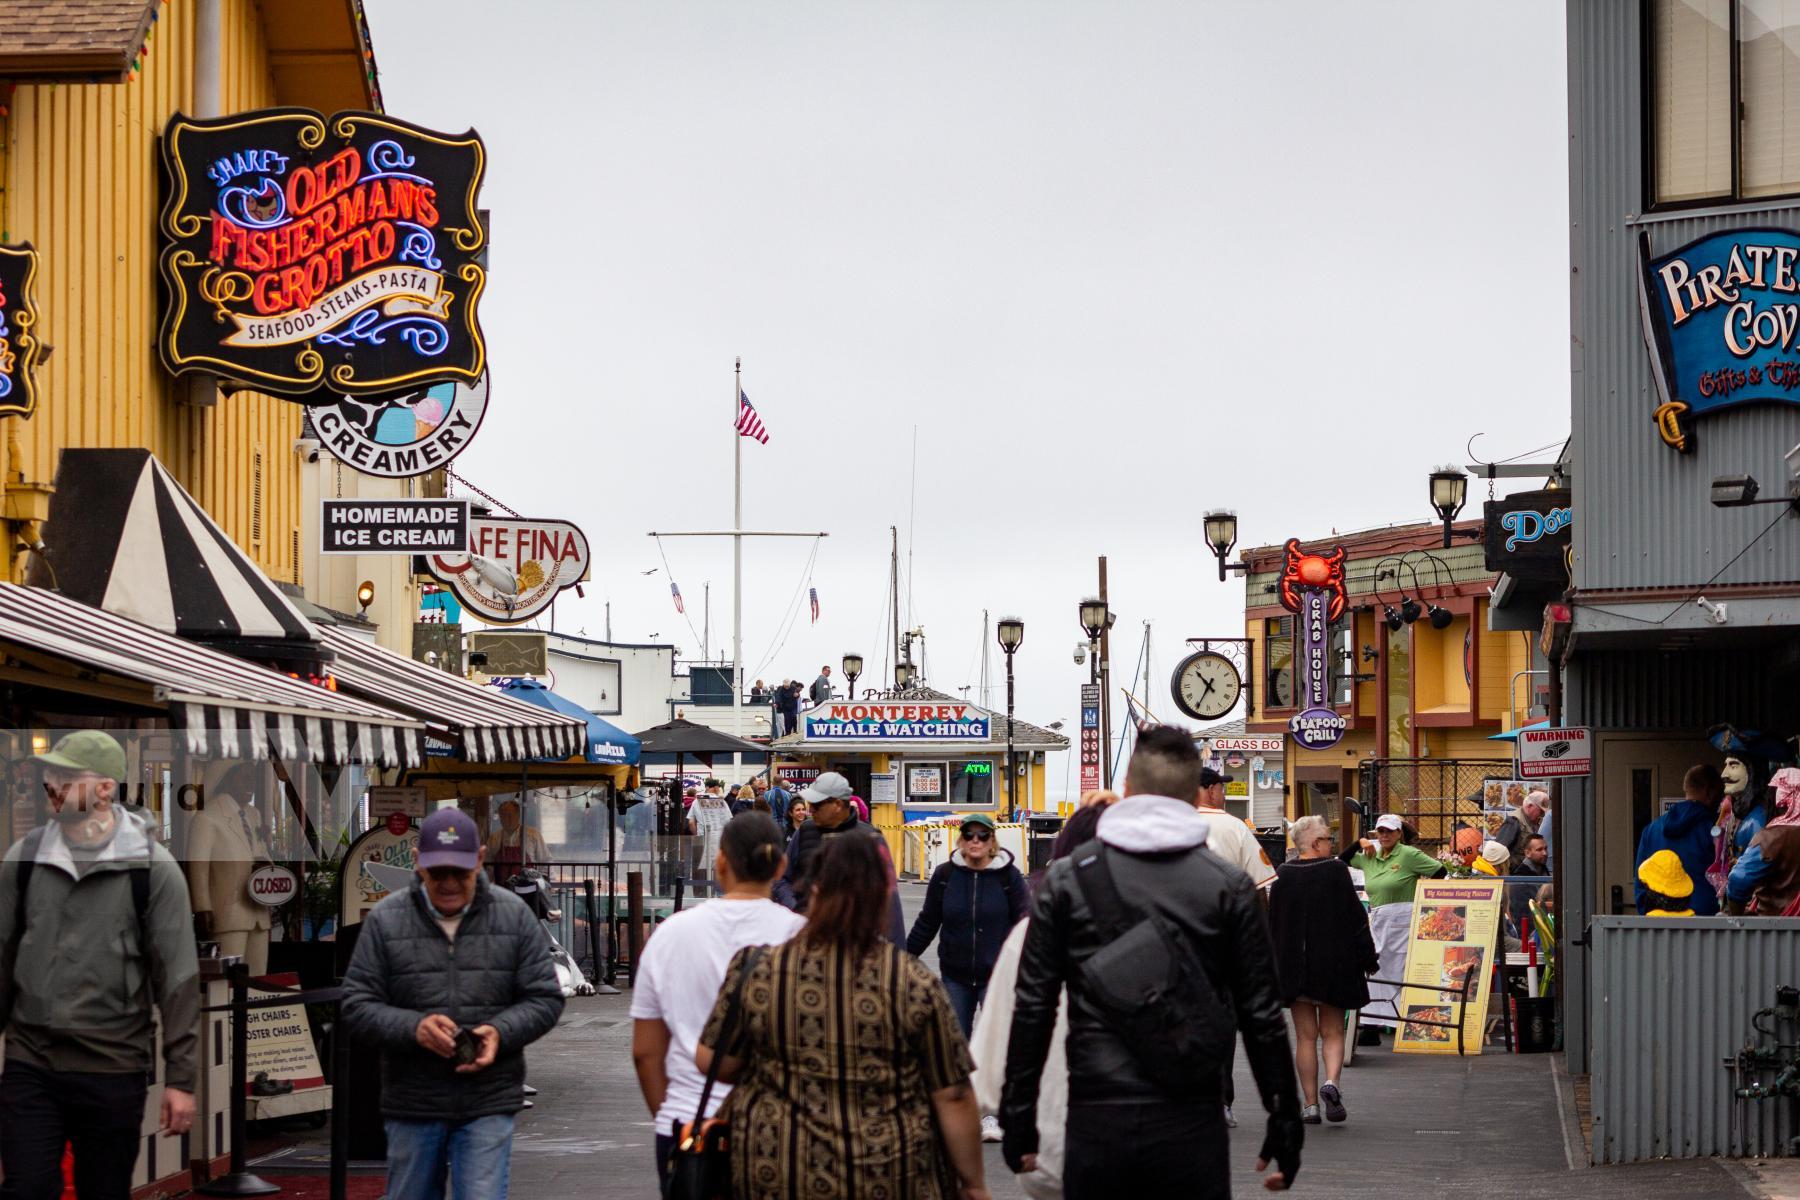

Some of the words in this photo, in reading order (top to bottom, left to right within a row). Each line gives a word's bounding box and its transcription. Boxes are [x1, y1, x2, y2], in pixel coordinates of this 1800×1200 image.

[286, 147, 361, 216] OLD
[209, 178, 439, 267] FISHERMAN'S
[253, 219, 396, 315] GROTTO
[1658, 244, 1800, 326] PIRATE
[1723, 300, 1800, 356] COV
[1699, 366, 1747, 397] Gifts
[1749, 366, 1762, 385] &
[319, 408, 473, 473] CREAMERY
[331, 507, 459, 524] HOMEMADE
[335, 529, 370, 546] ICE
[377, 529, 455, 546] CREAM
[516, 528, 580, 575] FINA
[1311, 598, 1322, 642] CRAB
[1312, 648, 1322, 703] HOUSE
[862, 688, 934, 701] Princess
[829, 705, 968, 721] MONTEREY
[812, 723, 881, 737] WHALE
[883, 723, 983, 737] WATCHING
[1292, 715, 1347, 733] SEAFOOD
[1215, 739, 1258, 750] GLASS
[1304, 729, 1337, 743] GRILL
[1526, 729, 1585, 743] WARNING
[779, 769, 799, 779] NEXT
[802, 769, 820, 779] TRIP
[965, 764, 990, 773] ATM
[1523, 766, 1544, 775] VIDEO
[1544, 764, 1590, 773] SURVEILLANCE
[789, 783, 809, 793] 2:3
[253, 877, 292, 895] CLOSED
[261, 1009, 290, 1021] CHAIRS
[245, 1028, 271, 1041] OSTER
[272, 1025, 302, 1038] CHAIRS
